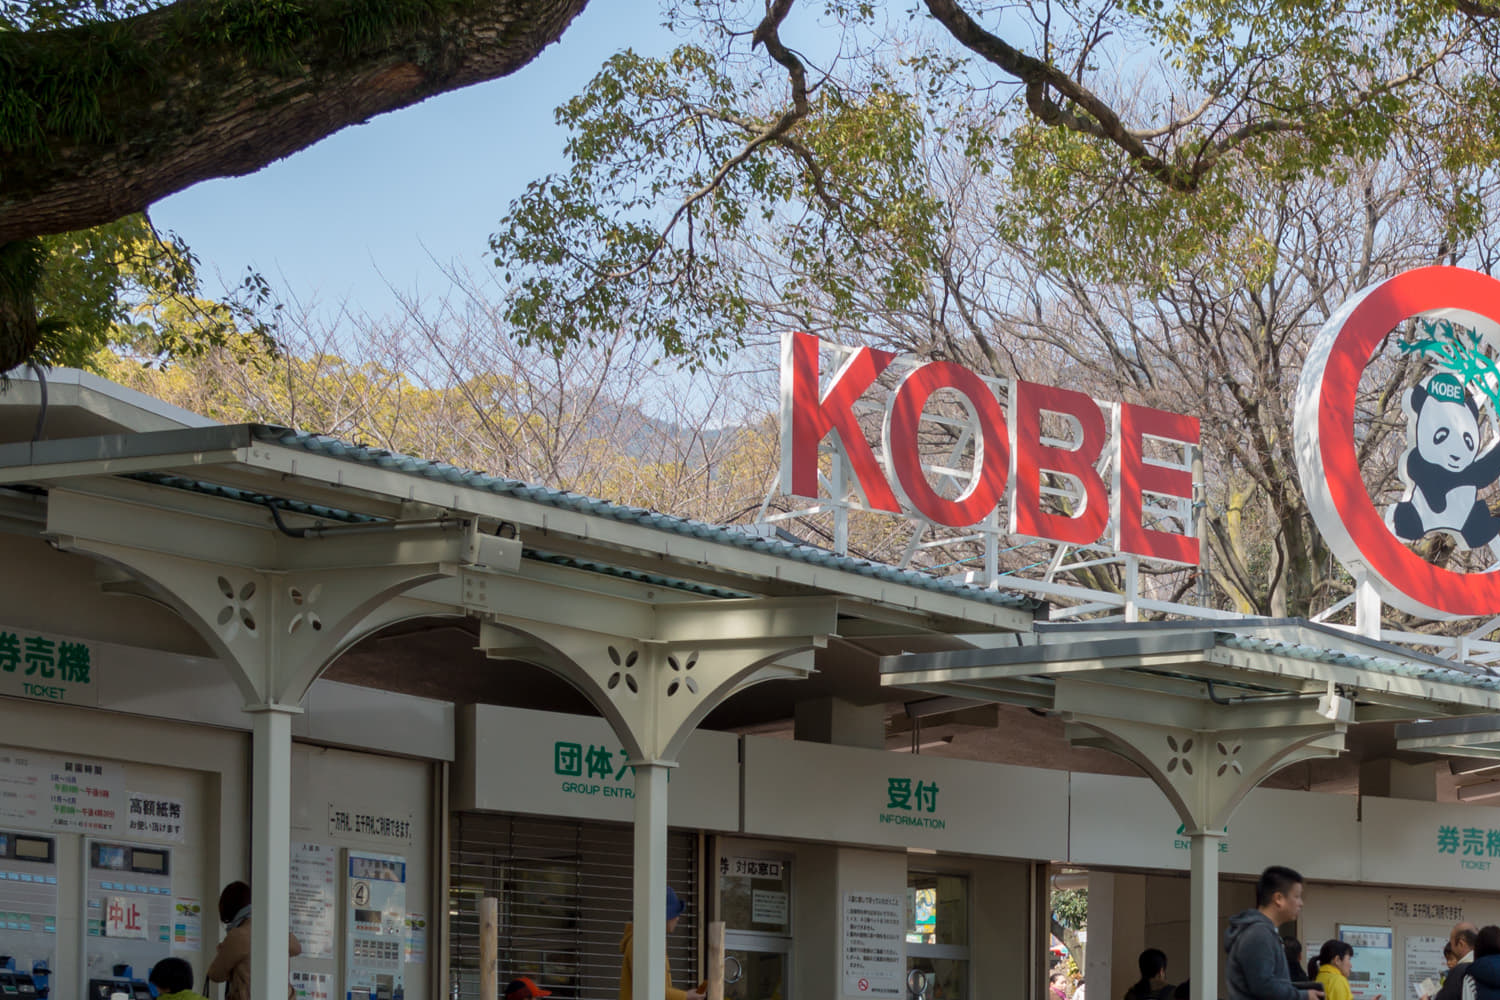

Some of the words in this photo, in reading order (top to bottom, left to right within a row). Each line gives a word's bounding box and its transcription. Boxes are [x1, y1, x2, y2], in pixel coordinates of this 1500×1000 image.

[1431, 380, 1462, 399] KOBE
[787, 331, 1200, 566] KOBE
[0, 631, 90, 684] 券売機
[23, 683, 66, 700] TICKET
[562, 782, 600, 795] GROUP
[887, 778, 939, 812] 受付
[880, 814, 945, 829] INFORMATION
[1461, 860, 1491, 871] TICKET
[109, 901, 142, 930] 中止
